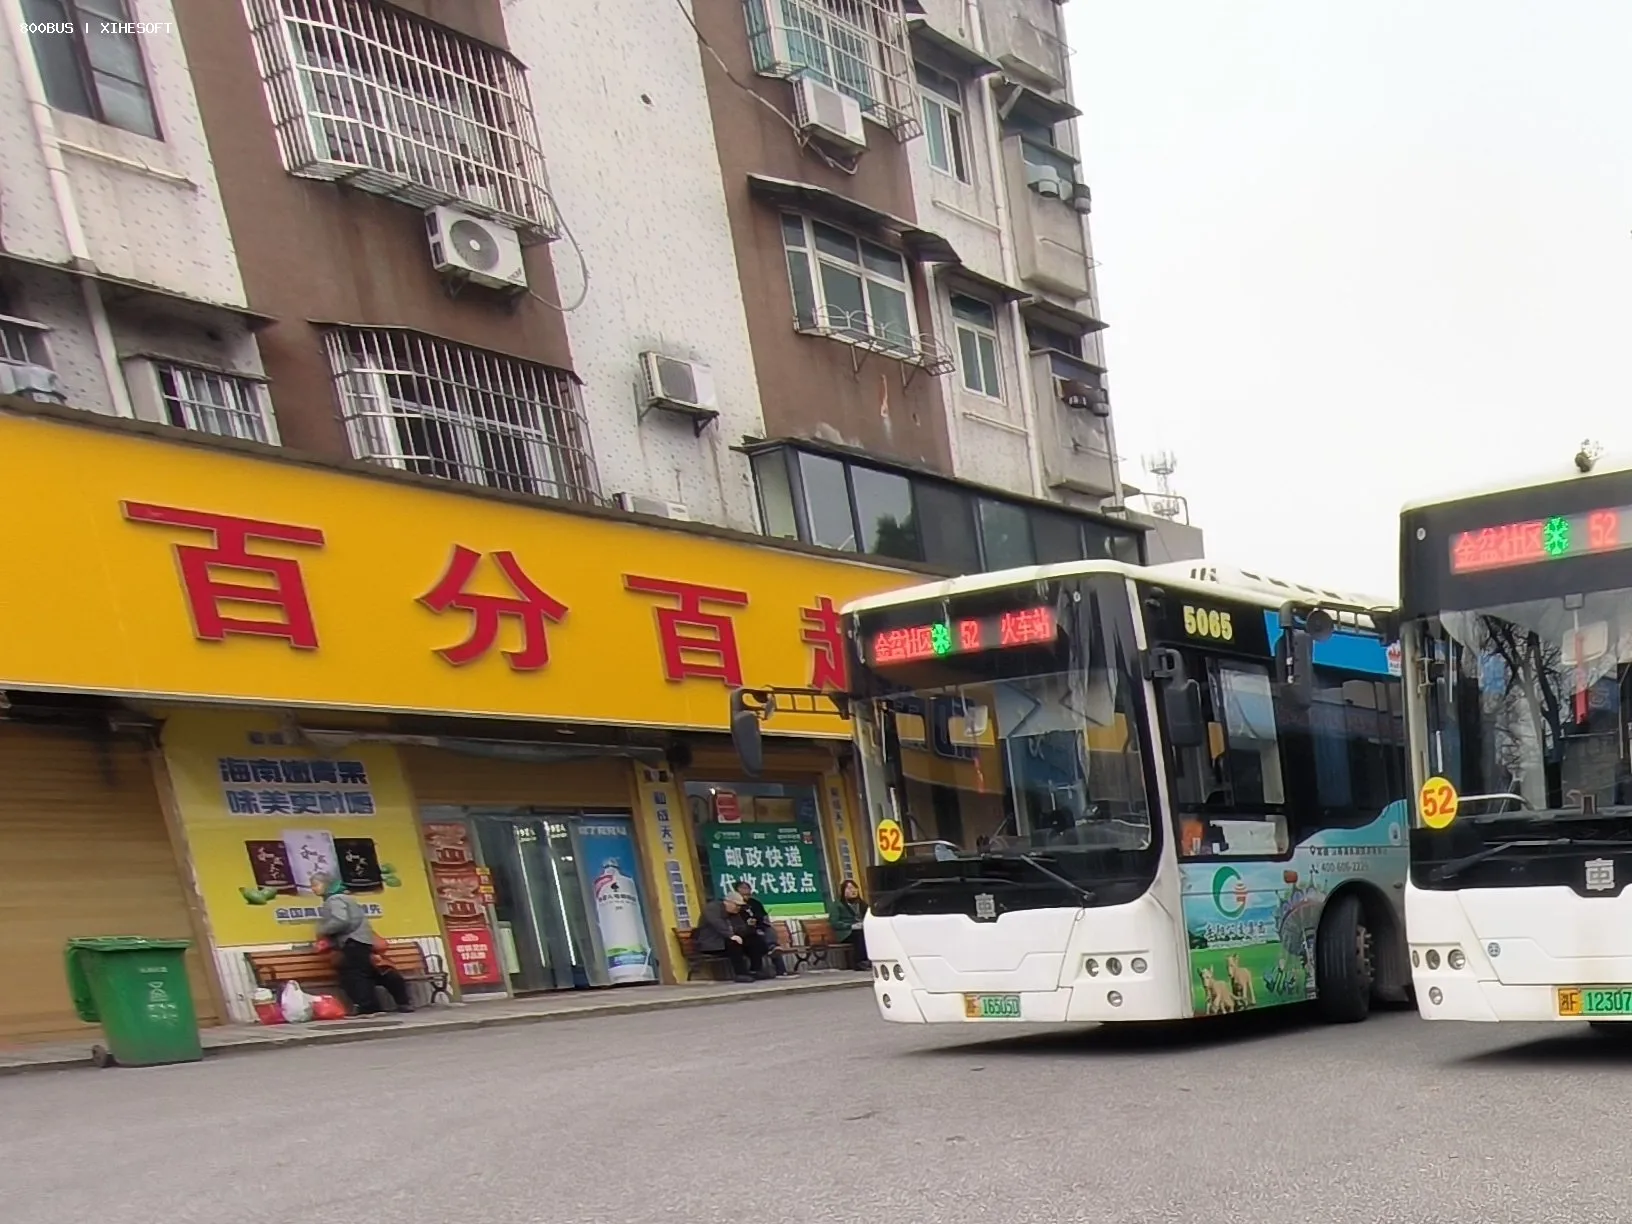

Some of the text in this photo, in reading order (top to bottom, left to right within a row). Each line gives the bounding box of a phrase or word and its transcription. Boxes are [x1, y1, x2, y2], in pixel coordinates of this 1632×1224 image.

[1588, 512, 1618, 551] 52
[960, 620, 980, 650] 52
[1001, 608, 1051, 645] 火车站
[1183, 605, 1232, 640] 5065
[1420, 785, 1456, 819] 52
[878, 826, 902, 853] 52
[724, 845, 804, 869] 邮政快递
[720, 872, 817, 895] 代收代投点
